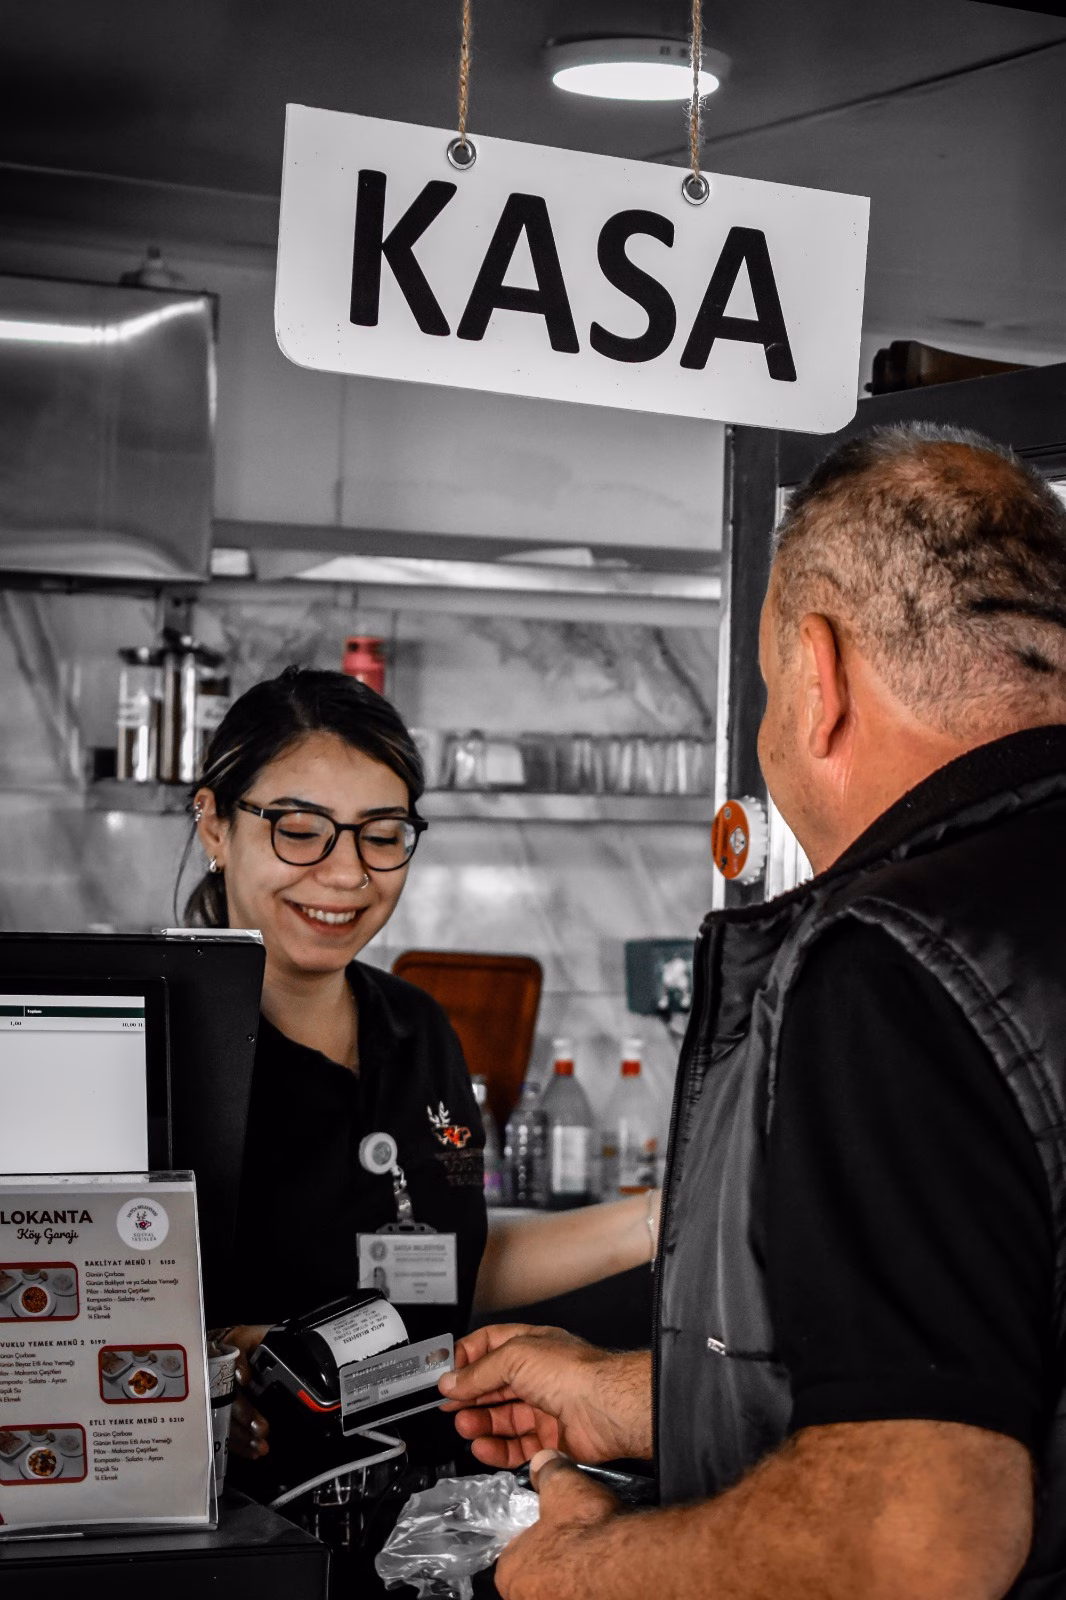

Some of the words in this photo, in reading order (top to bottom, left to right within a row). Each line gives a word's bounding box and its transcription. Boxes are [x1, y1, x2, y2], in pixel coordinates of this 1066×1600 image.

[349, 168, 797, 384] KASA
[0, 1210, 94, 1224] LOKANTA
[17, 1228, 42, 1244] Köy
